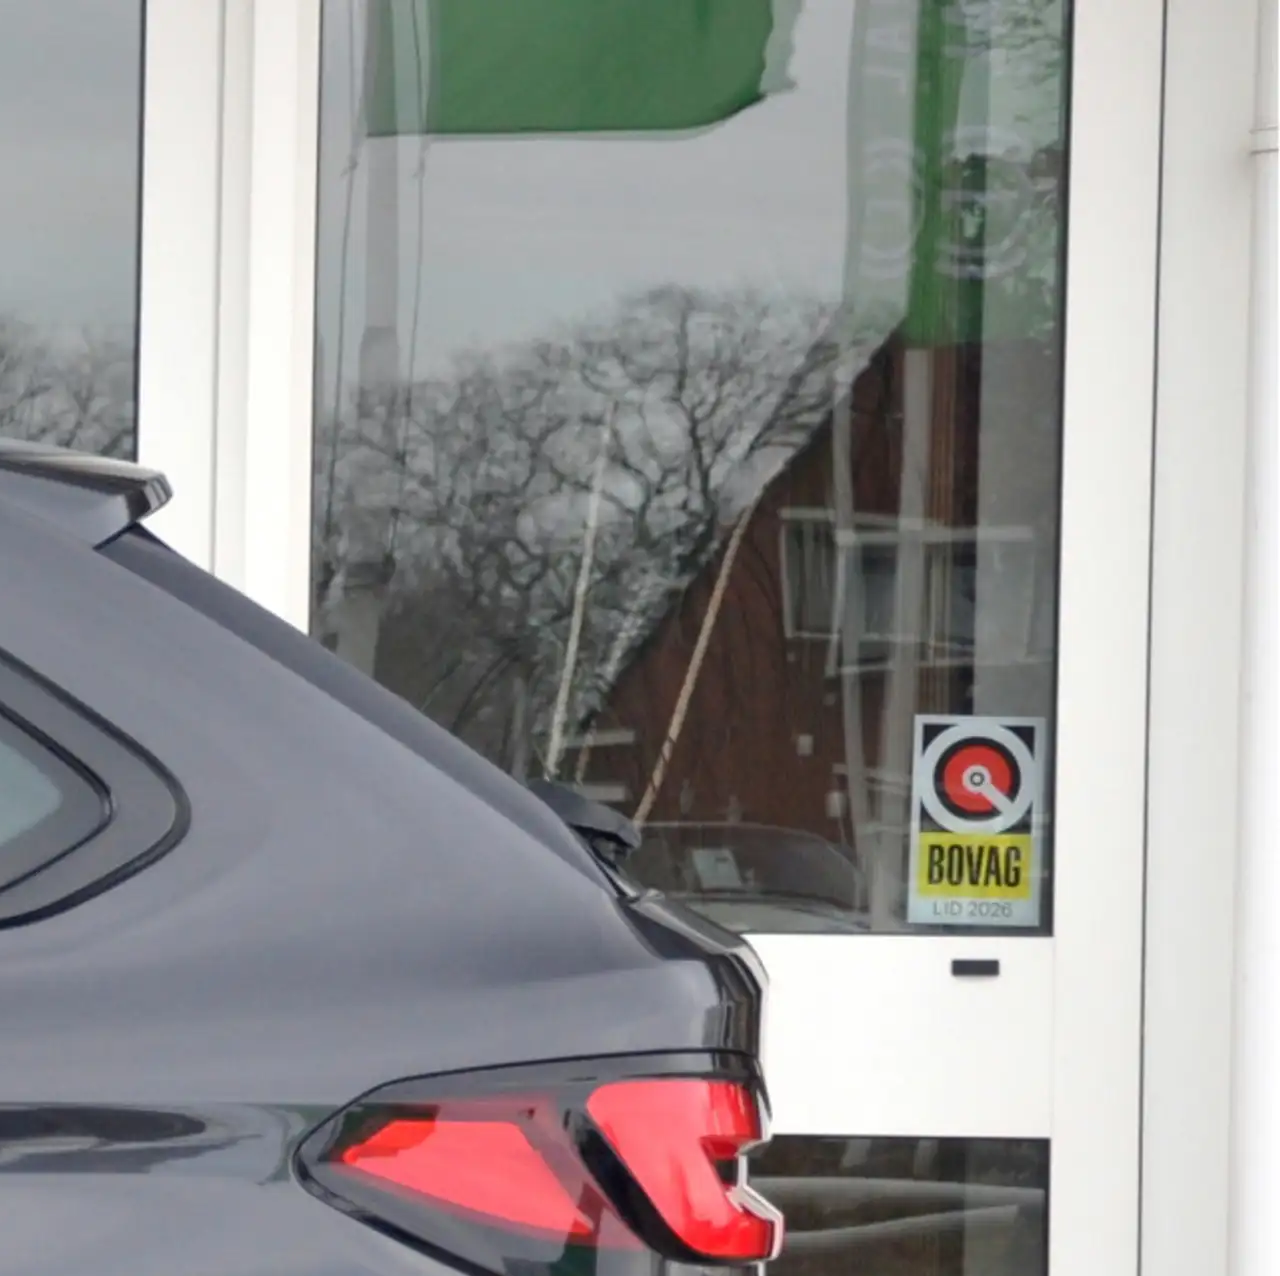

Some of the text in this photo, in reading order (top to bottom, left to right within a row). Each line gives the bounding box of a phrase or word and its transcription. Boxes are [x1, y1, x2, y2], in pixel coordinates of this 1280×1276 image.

[928, 844, 1021, 887] BOVAG
[933, 901, 1013, 918] LID 2026
